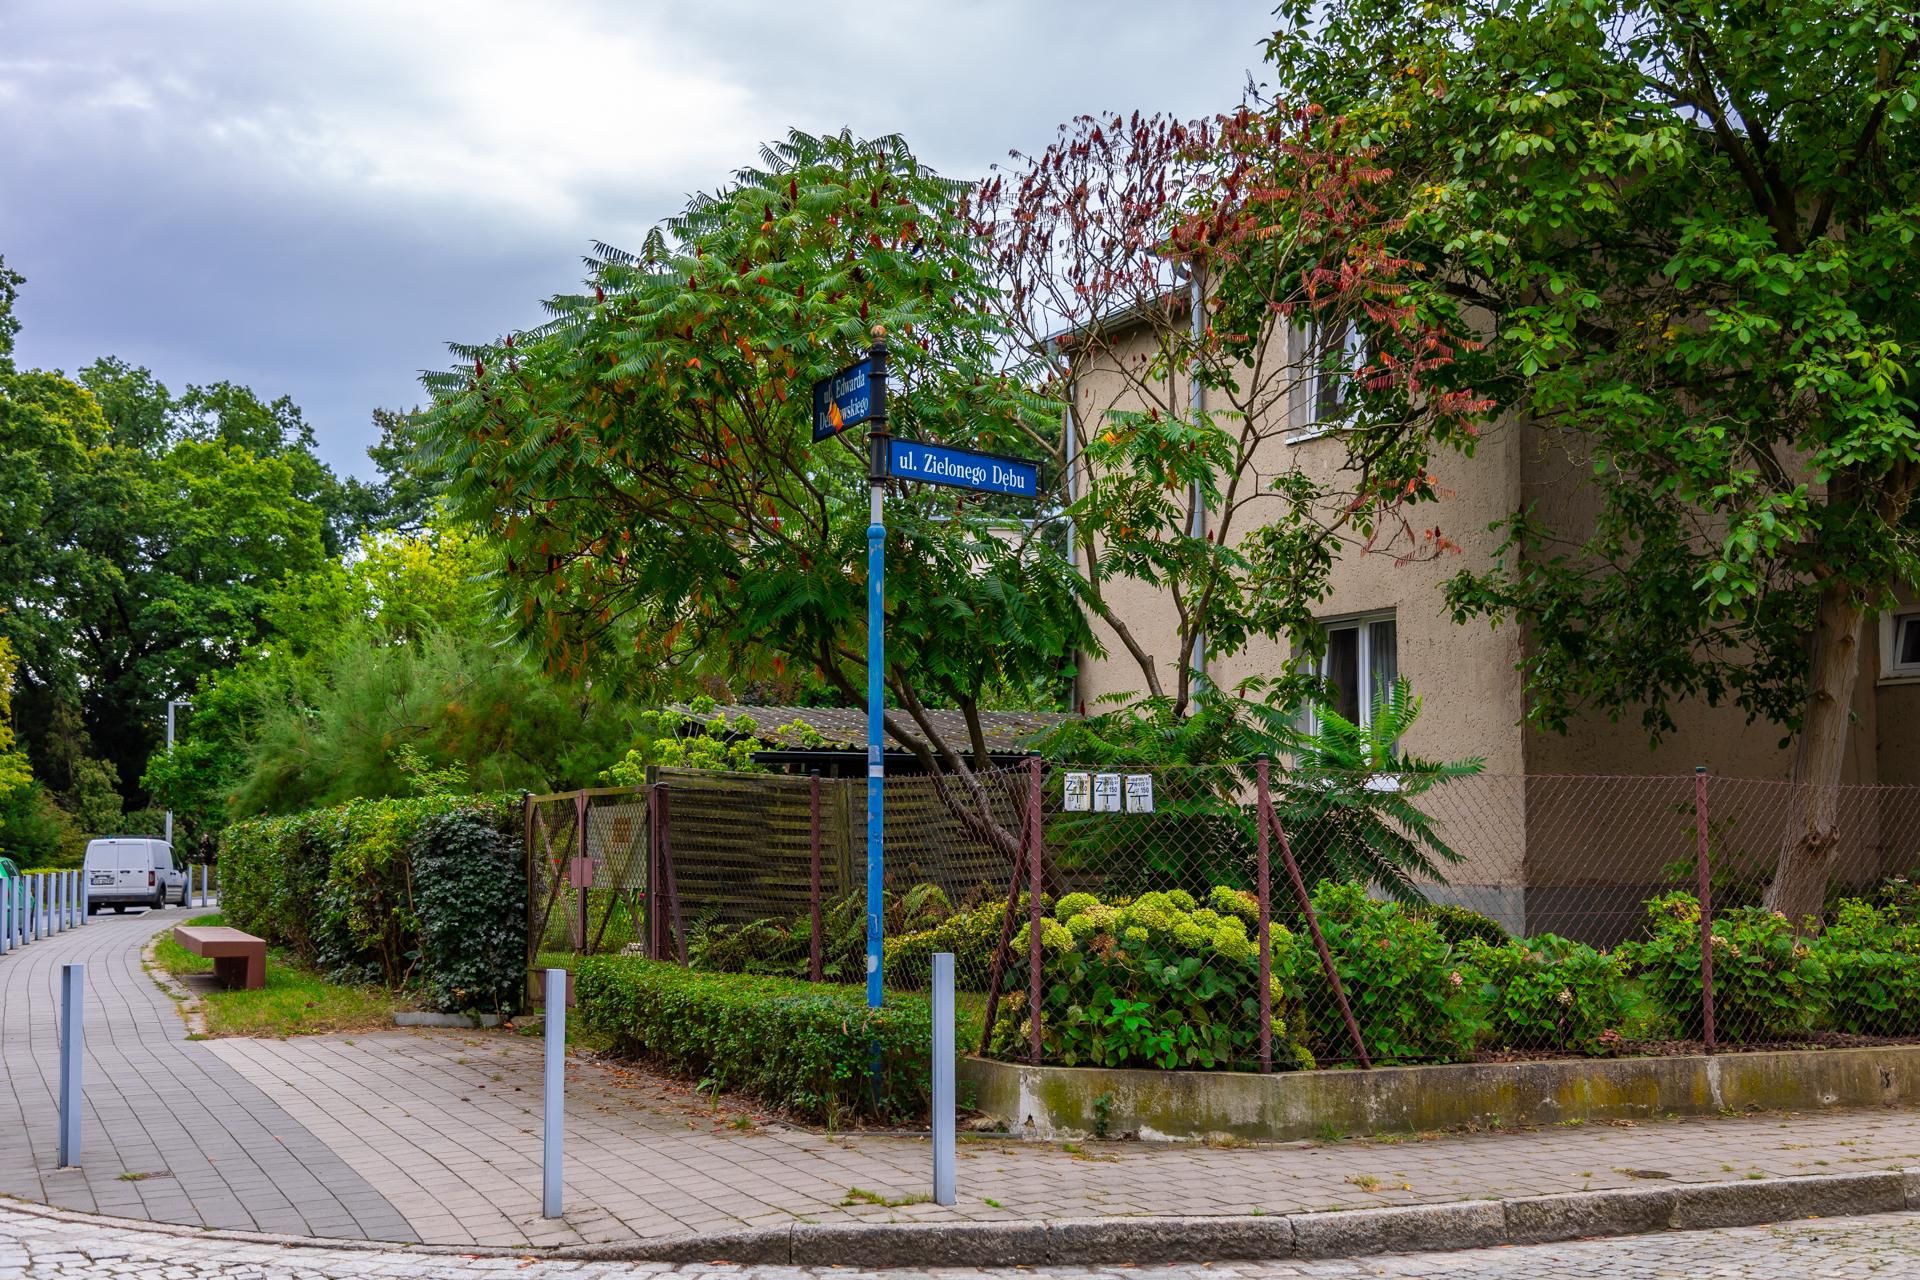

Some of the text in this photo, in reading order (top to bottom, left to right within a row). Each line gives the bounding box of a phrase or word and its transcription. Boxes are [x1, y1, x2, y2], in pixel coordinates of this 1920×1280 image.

[835, 369, 865, 399] Edwarda
[819, 396, 869, 431] Demwskiego
[899, 451, 1025, 492] ul. Zielonego Dębu
[1066, 780, 1073, 791] Z
[1096, 781, 1103, 792] Z
[1127, 783, 1135, 793] Z
